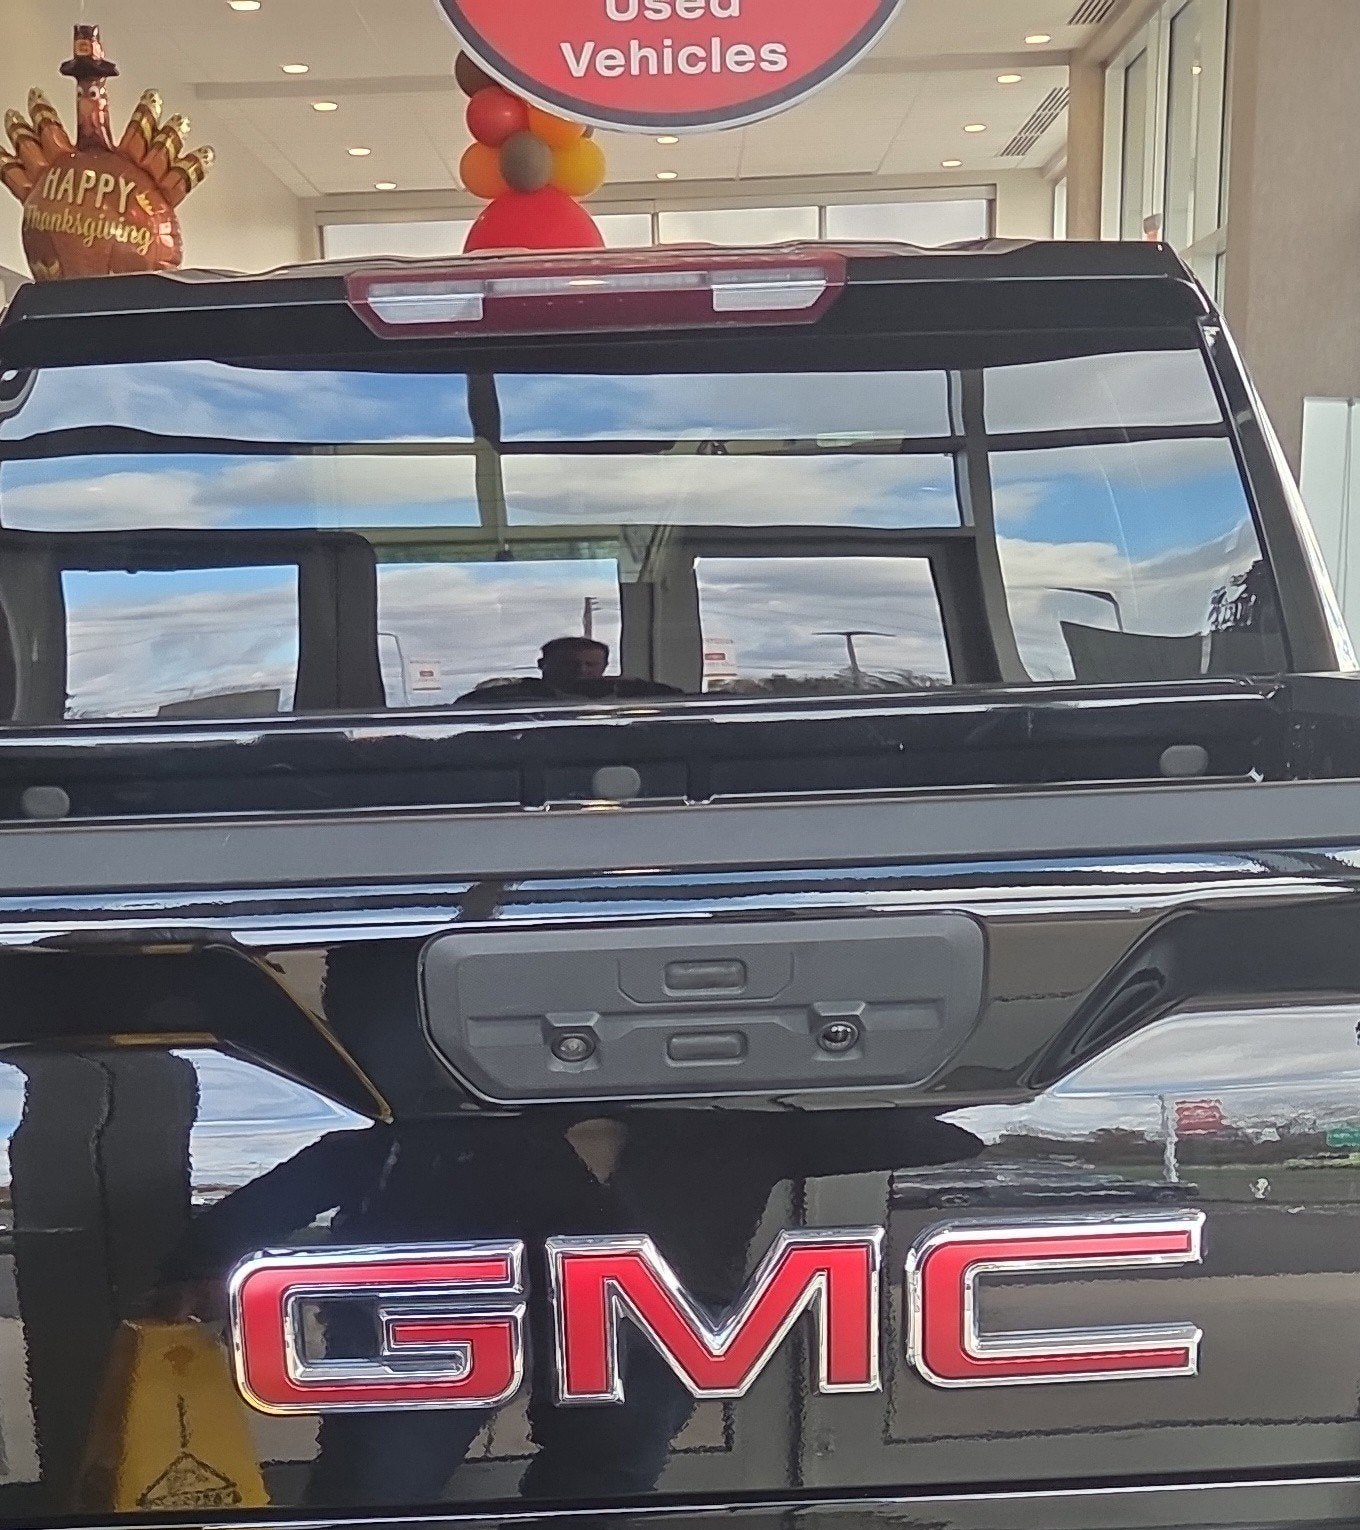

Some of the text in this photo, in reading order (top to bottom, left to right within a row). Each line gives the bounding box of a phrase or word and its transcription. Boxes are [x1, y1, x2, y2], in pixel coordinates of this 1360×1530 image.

[559, 37, 789, 78] Vehicles
[42, 167, 136, 214] HAPPY
[24, 203, 154, 256] Thanksgiving
[228, 1210, 1207, 1416] GMC
